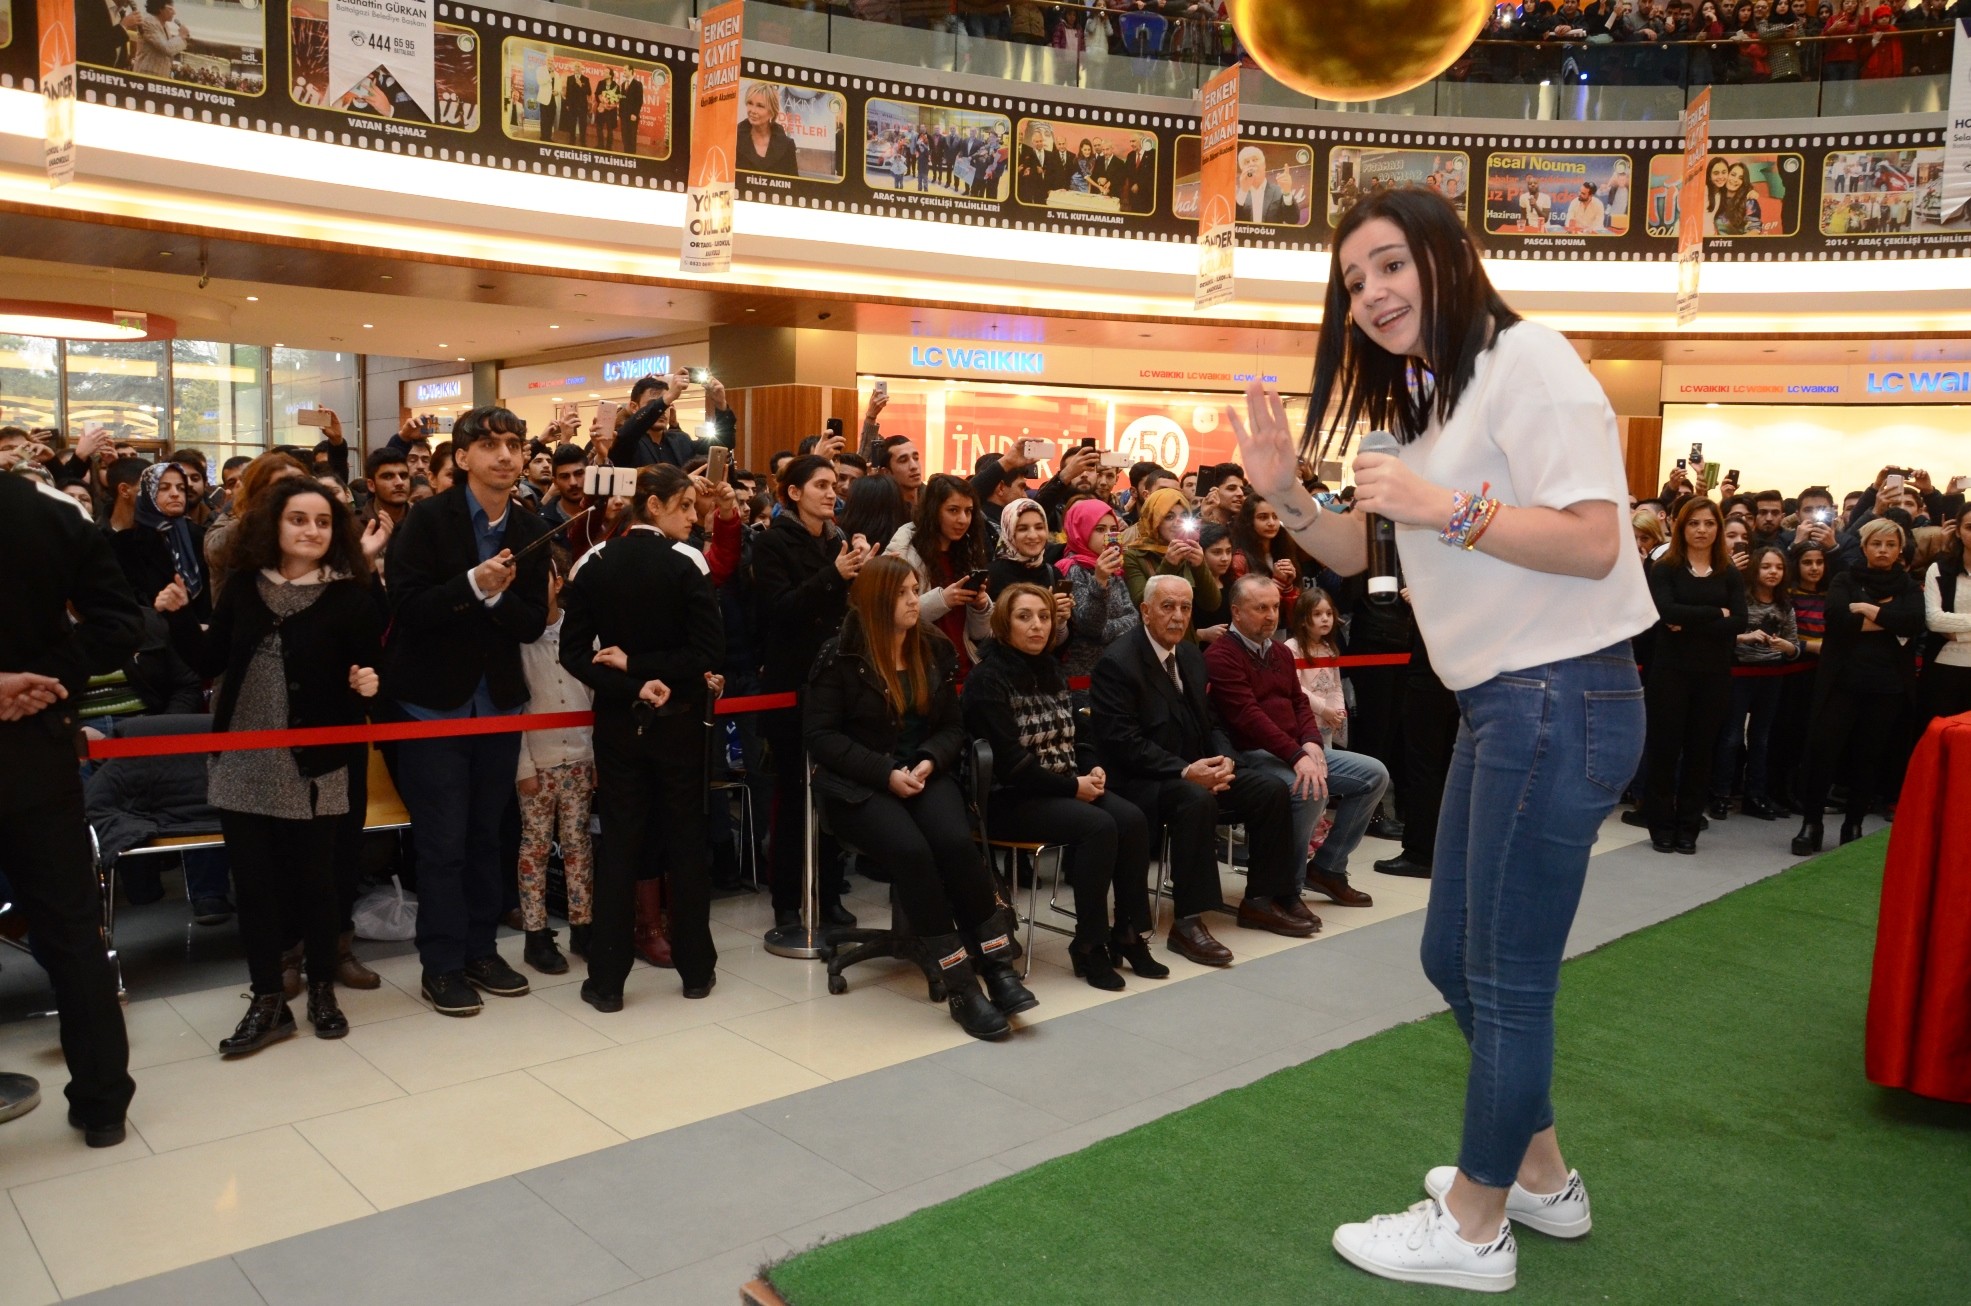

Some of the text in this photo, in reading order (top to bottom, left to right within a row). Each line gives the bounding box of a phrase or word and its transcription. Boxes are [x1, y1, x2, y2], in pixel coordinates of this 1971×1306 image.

[336, 4, 427, 28] Battalgazi Belediye Başkanı
[385, 2, 427, 19] GÜRKAN
[704, 15, 741, 44] ERKEN
[368, 33, 391, 52] 444
[394, 37, 404, 48] 65
[405, 39, 415, 49] 95
[704, 39, 739, 69] KAYIT
[703, 65, 739, 91] ZAMANI
[79, 69, 236, 108] SÜHEYL ve BEHSAT UYGUR
[1204, 78, 1237, 111] ERKEN
[1204, 99, 1237, 133] KAYIT
[347, 117, 427, 139] VATAN ŞAŞMAZ
[1203, 121, 1236, 150] ZAMANI
[539, 147, 637, 169] EV ÇEKİLİŞİ TALİHLİSİ
[1529, 156, 1586, 174] Nouma
[746, 174, 792, 189] FİLİZ AKIN
[872, 192, 1001, 213] ARAÇ ve EV ÇEKİLİŞİ TALİHLİLERİ
[1046, 210, 1124, 225] 5. YIL KUTLAMALARI
[1486, 209, 1522, 219] Haziran
[1201, 230, 1233, 249] ÖNDER
[1524, 237, 1586, 247] PASCAL NOUMA
[1709, 238, 1733, 248] ATİYE
[1825, 238, 1848, 247] 2014
[1857, 237, 1881, 249] ARAÇ
[1883, 234, 1921, 247] ÇEKİLİŞİ
[911, 346, 944, 368] LC
[1140, 370, 1151, 378] LC
[1187, 372, 1198, 380] LC
[1867, 371, 1905, 393] LC
[1680, 385, 1692, 393] LC
[1733, 385, 1745, 393] LC
[1787, 385, 1800, 393] LC
